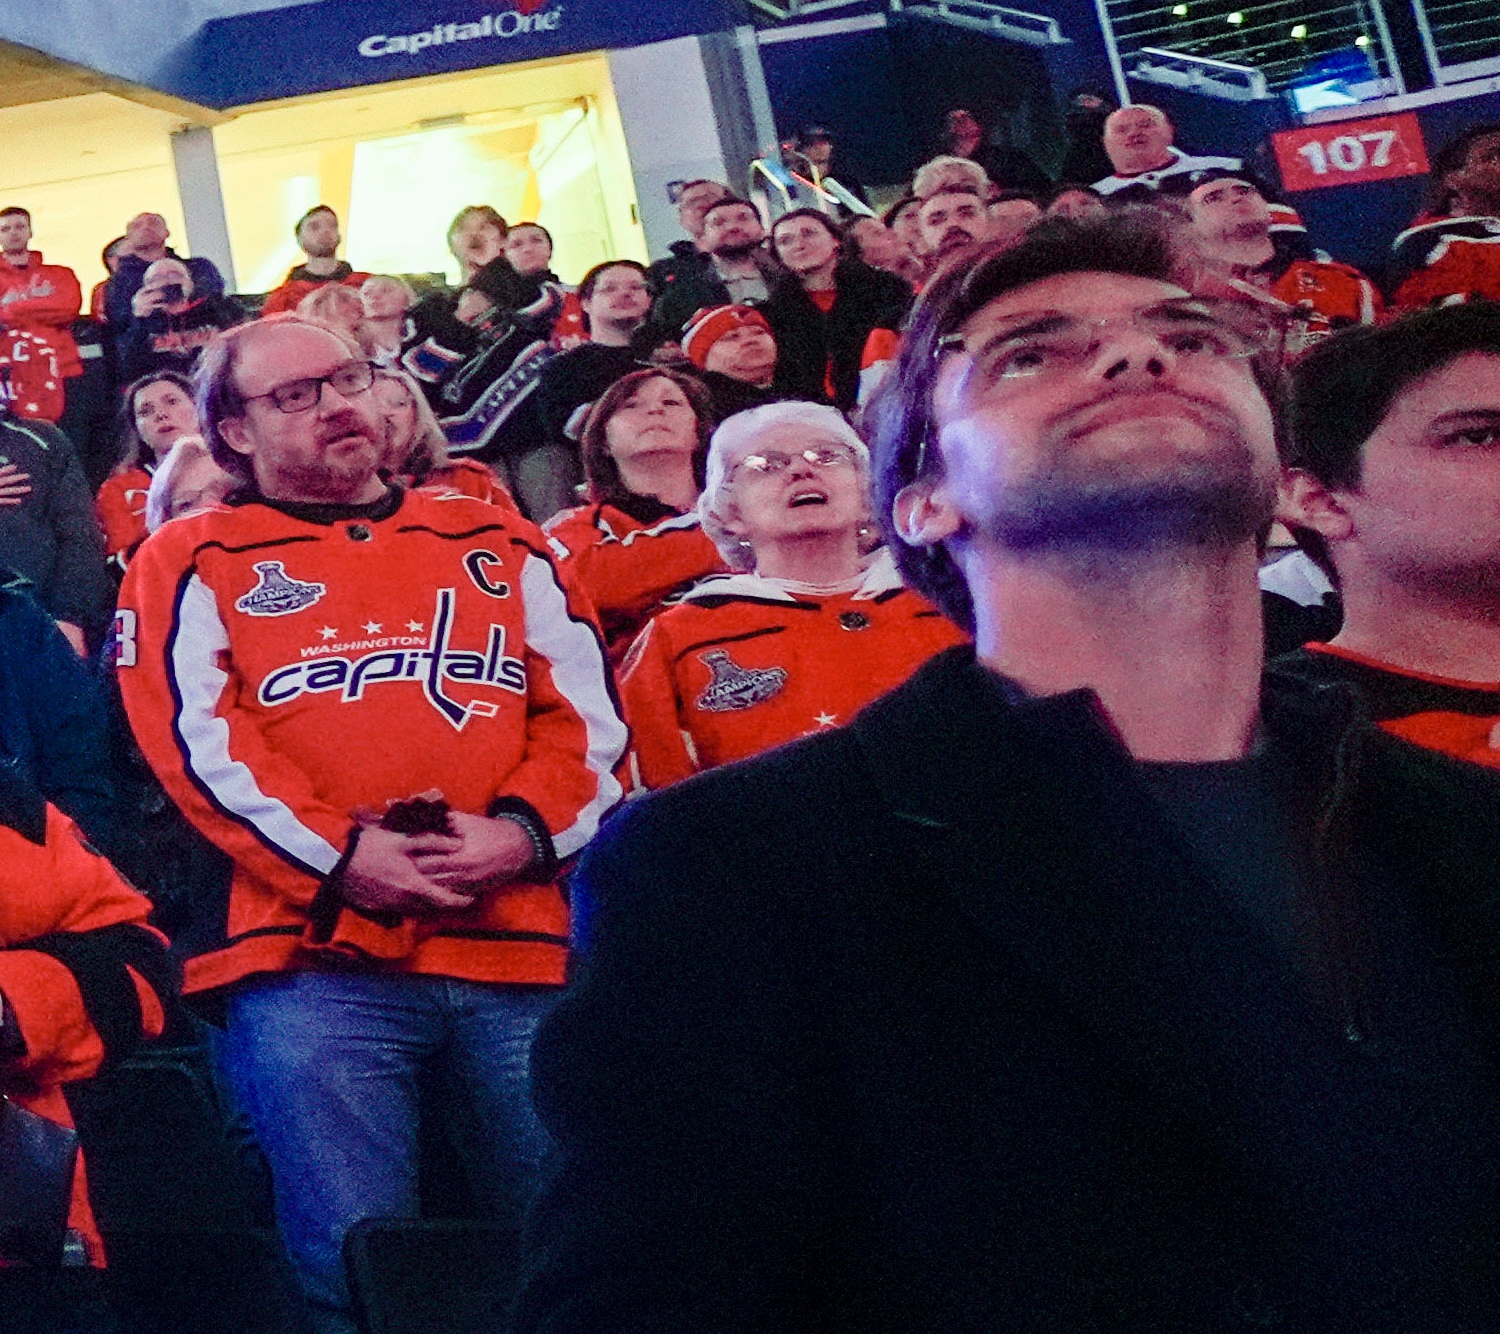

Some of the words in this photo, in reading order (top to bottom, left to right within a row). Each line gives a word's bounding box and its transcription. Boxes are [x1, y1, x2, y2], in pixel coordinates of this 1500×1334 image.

[1297, 131, 1397, 174] 107
[462, 549, 510, 599] C
[300, 636, 427, 658] WASHINGTON
